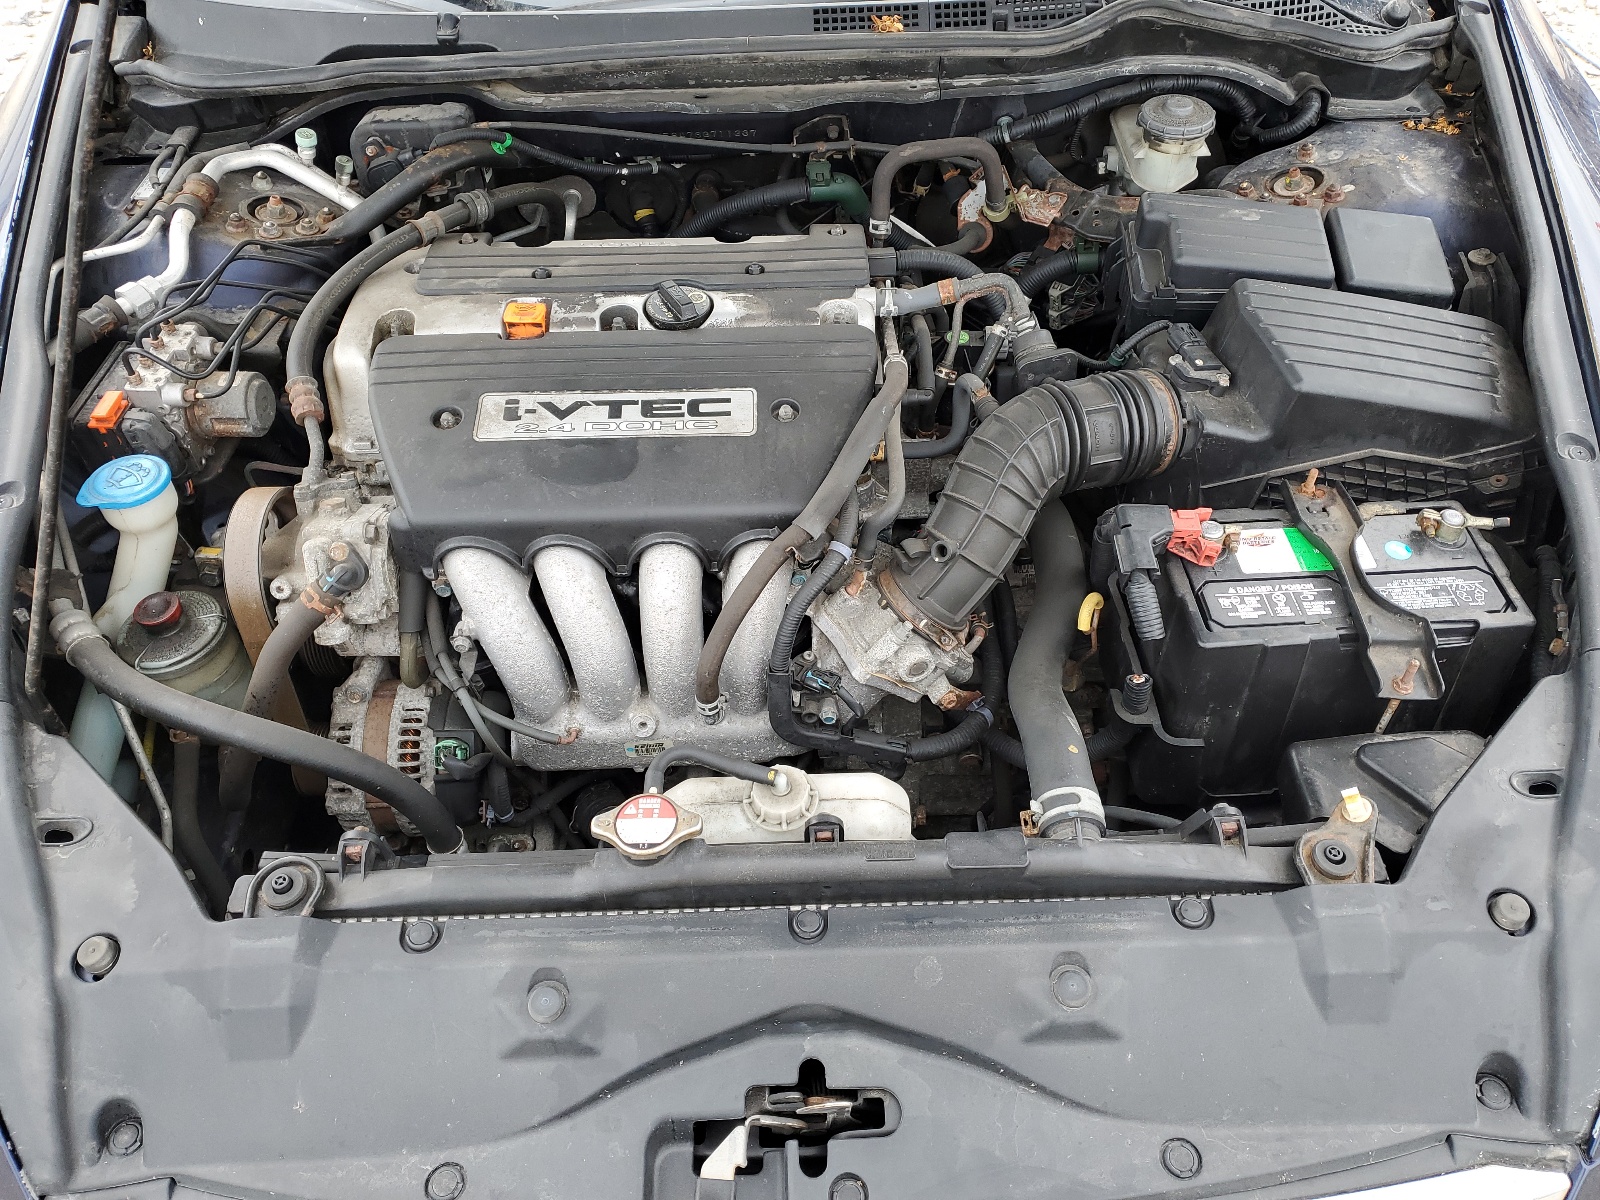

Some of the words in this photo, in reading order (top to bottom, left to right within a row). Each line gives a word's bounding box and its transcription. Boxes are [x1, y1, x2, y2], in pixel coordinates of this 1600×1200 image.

[502, 397, 732, 421] i-VTEC
[514, 422, 575, 434] 2.4
[584, 419, 718, 433] DOHC
[1237, 585, 1274, 593] DANGER
[1281, 583, 1315, 591] POISON
